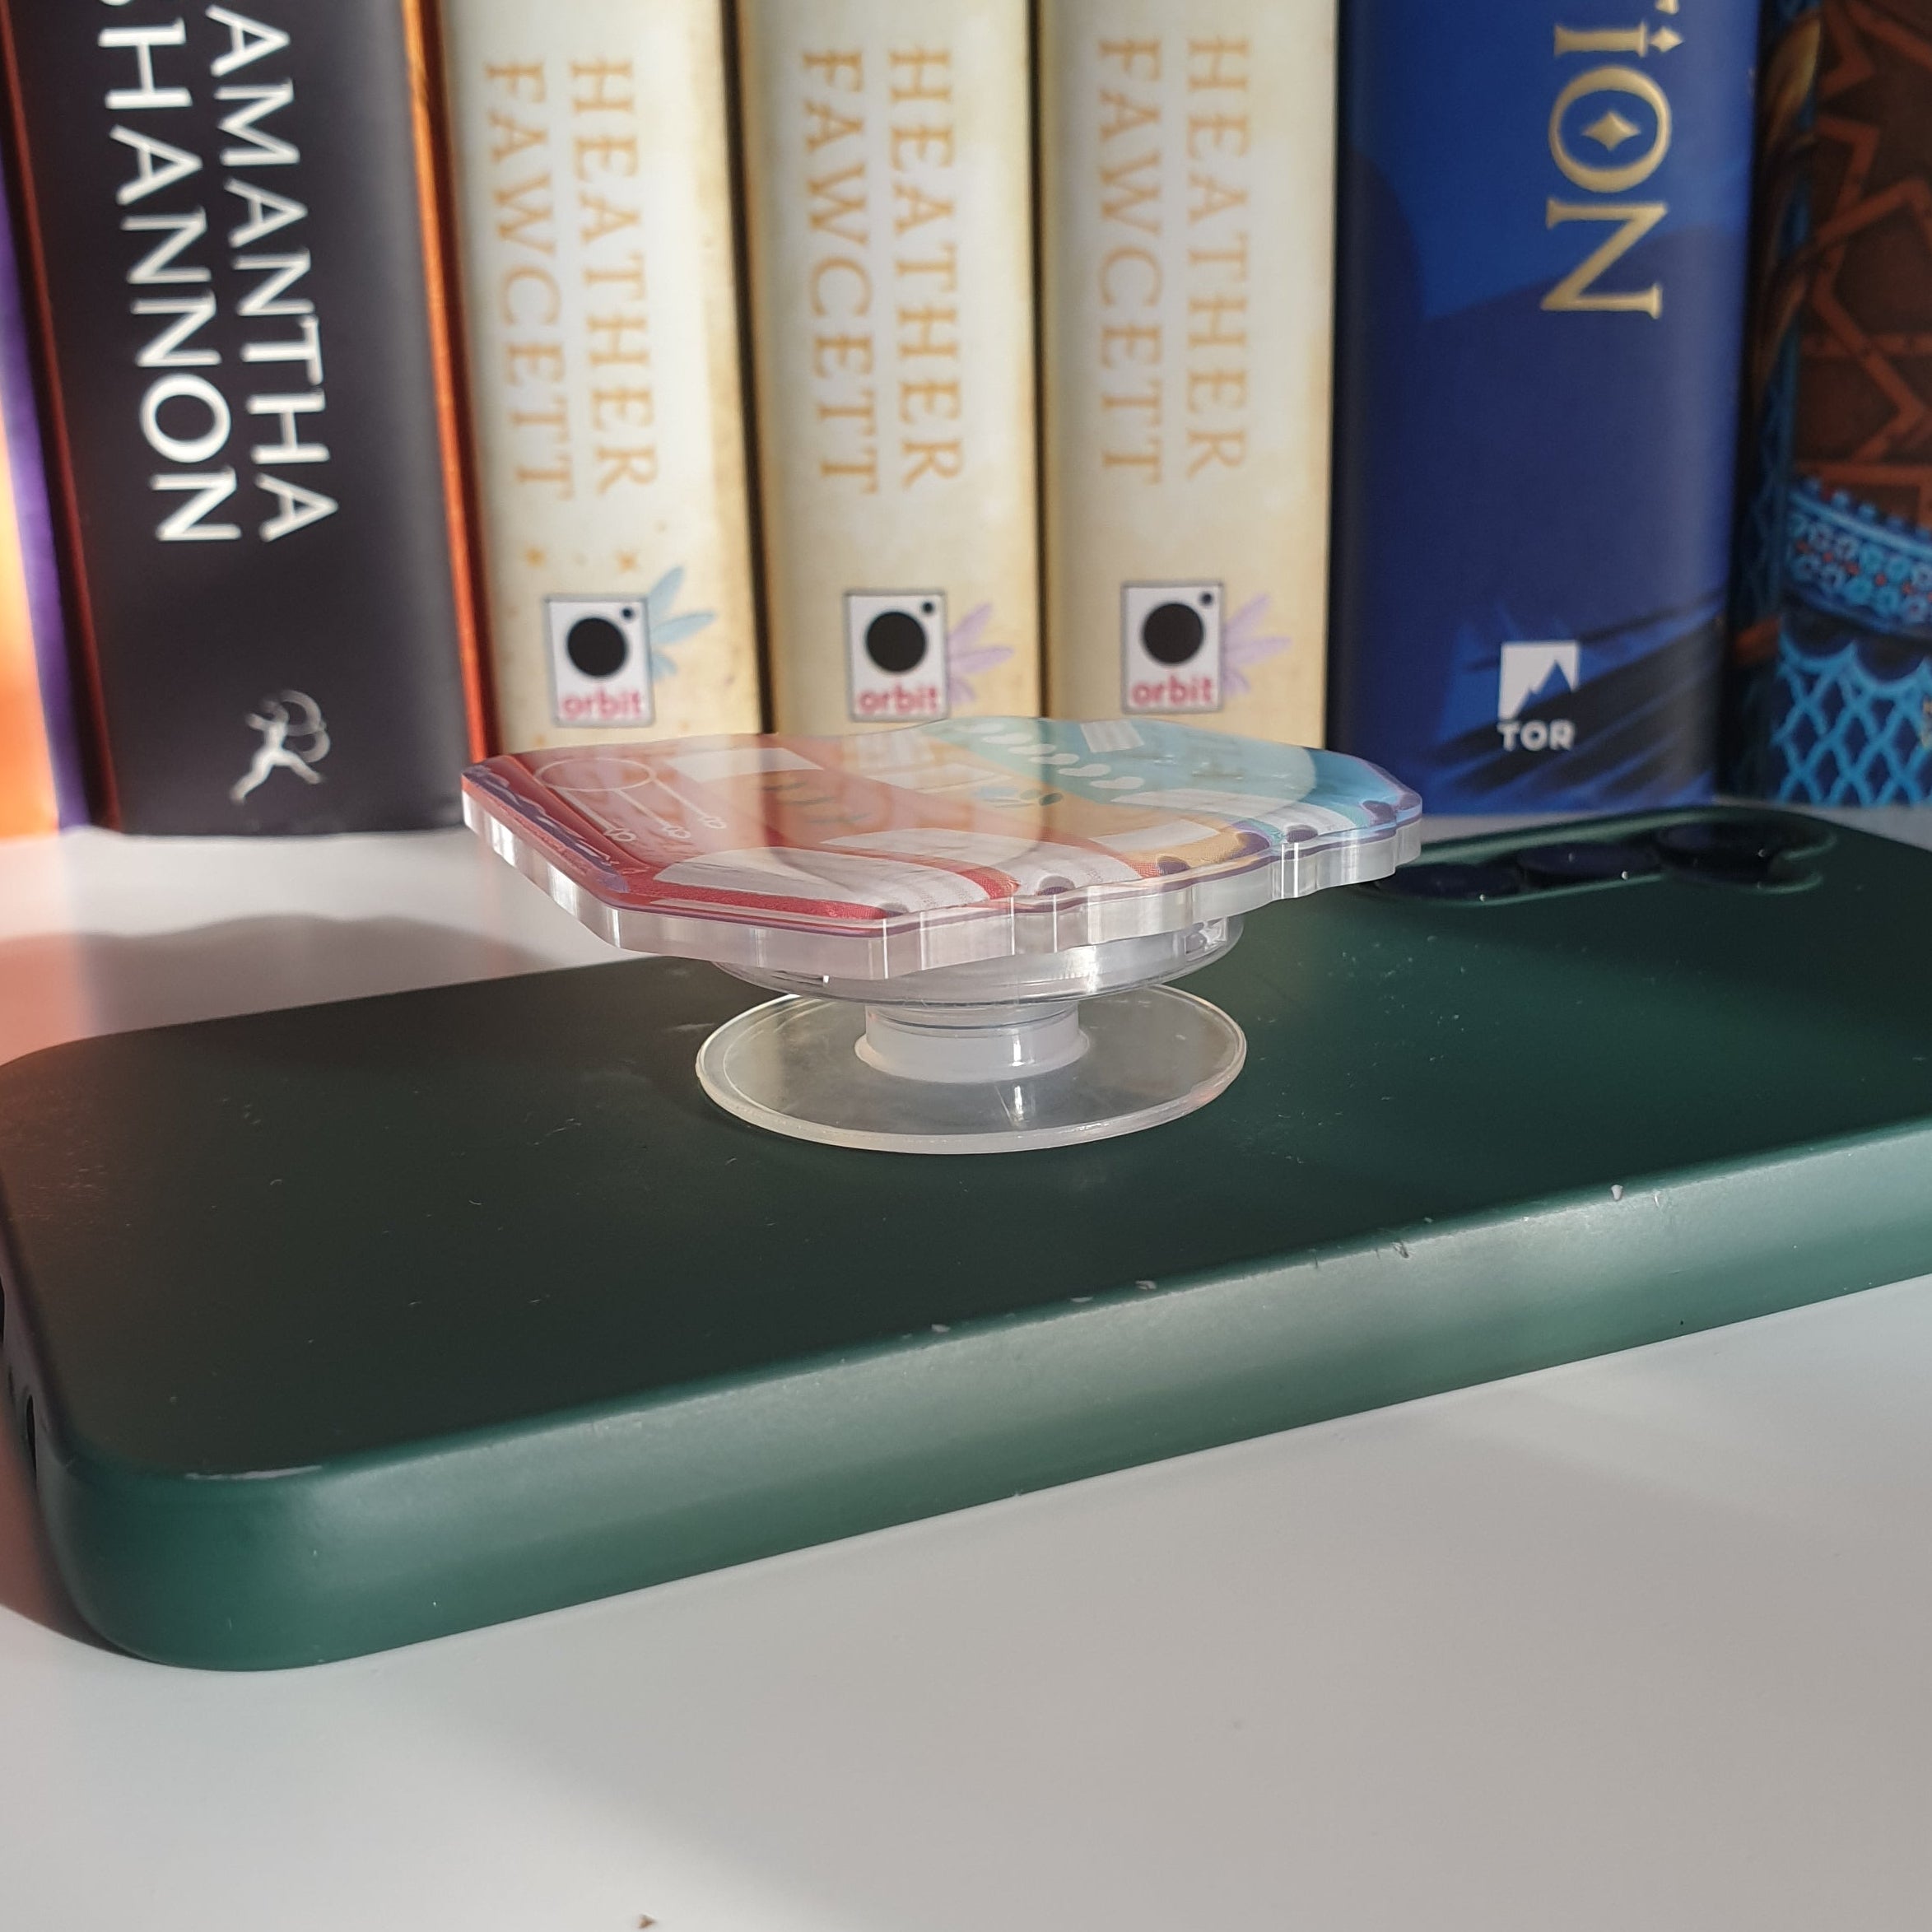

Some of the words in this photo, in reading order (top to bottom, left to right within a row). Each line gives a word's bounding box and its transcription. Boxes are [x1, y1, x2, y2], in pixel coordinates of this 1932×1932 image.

[97, 0, 241, 541] HANNON
[205, 3, 338, 542] AMANTHA
[485, 60, 573, 500] FAWCETT
[570, 58, 657, 495] HEATHER
[802, 49, 878, 494] FAWCETT
[888, 48, 964, 488] HEATHER
[1097, 36, 1164, 485] FAWCETT
[1185, 35, 1250, 477] HEATHER
[1541, 0, 1684, 319] ION
[561, 687, 642, 719] orbit
[857, 685, 941, 716] orbit
[1131, 675, 1213, 706] orbit
[1497, 719, 1576, 752] TOR
